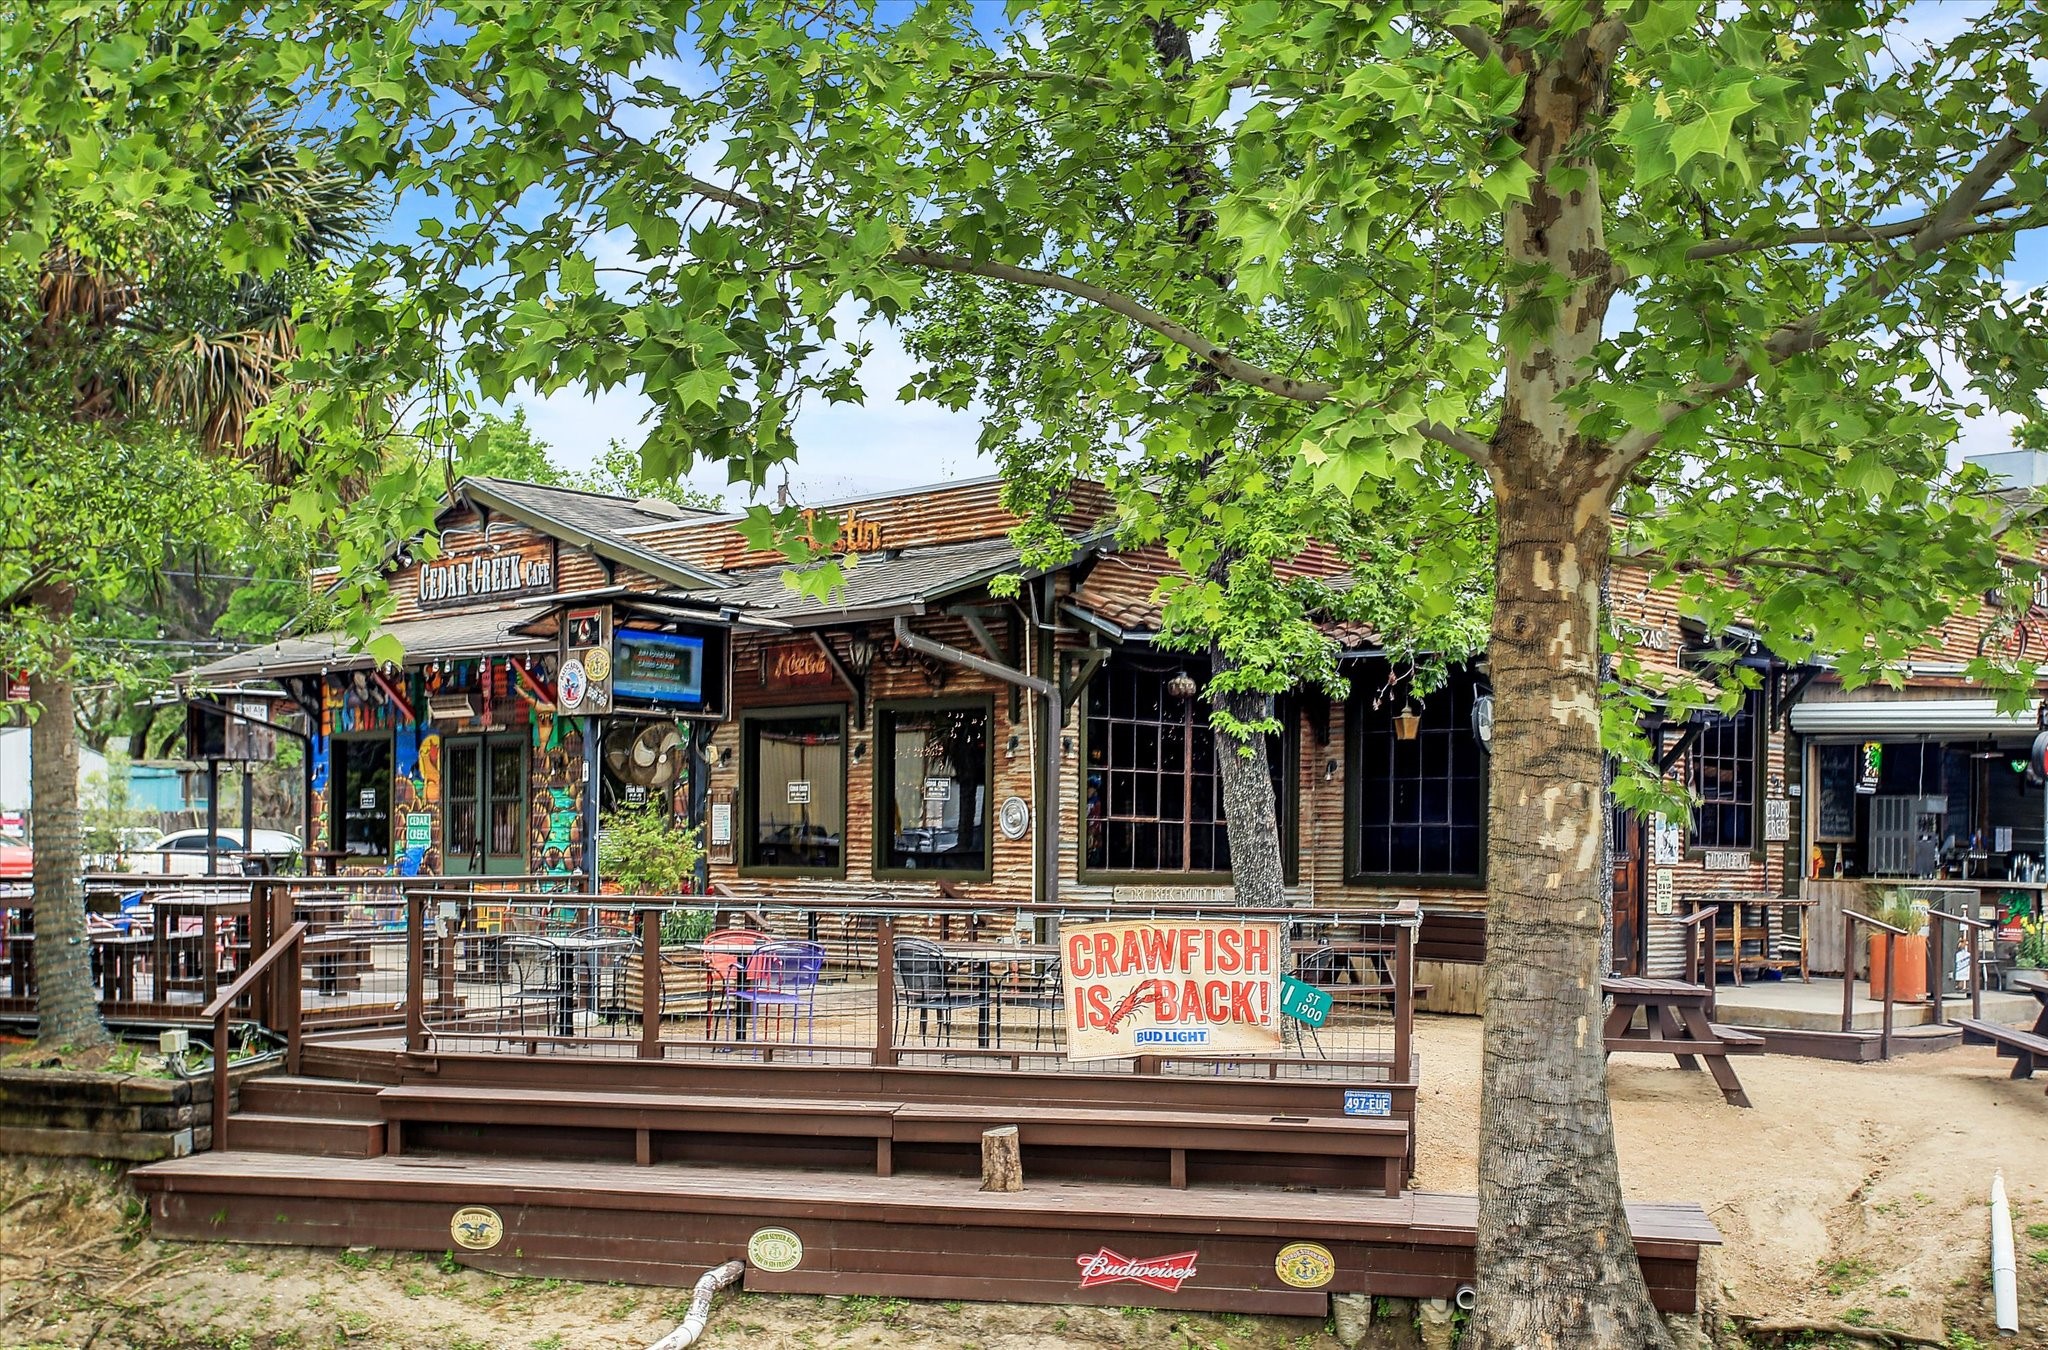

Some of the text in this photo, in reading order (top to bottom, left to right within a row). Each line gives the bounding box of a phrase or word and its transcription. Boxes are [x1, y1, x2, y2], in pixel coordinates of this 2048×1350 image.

[420, 554, 550, 600] CEDAR CREEK CAFE
[1766, 800, 1789, 818] CEDAR
[409, 816, 428, 825] CEDAR
[1766, 820, 1790, 839] CREEK
[409, 829, 428, 840] CREEK
[1068, 928, 1271, 979] CRAWFISH
[1074, 979, 1272, 1031] IS BACK!
[1305, 992, 1321, 1006] ST
[1295, 1002, 1323, 1022] 1900
[1136, 1031, 1207, 1044] BUD LIGHT
[1346, 1097, 1389, 1110] 497-EUE
[1077, 1255, 1197, 1279] Budweiser
